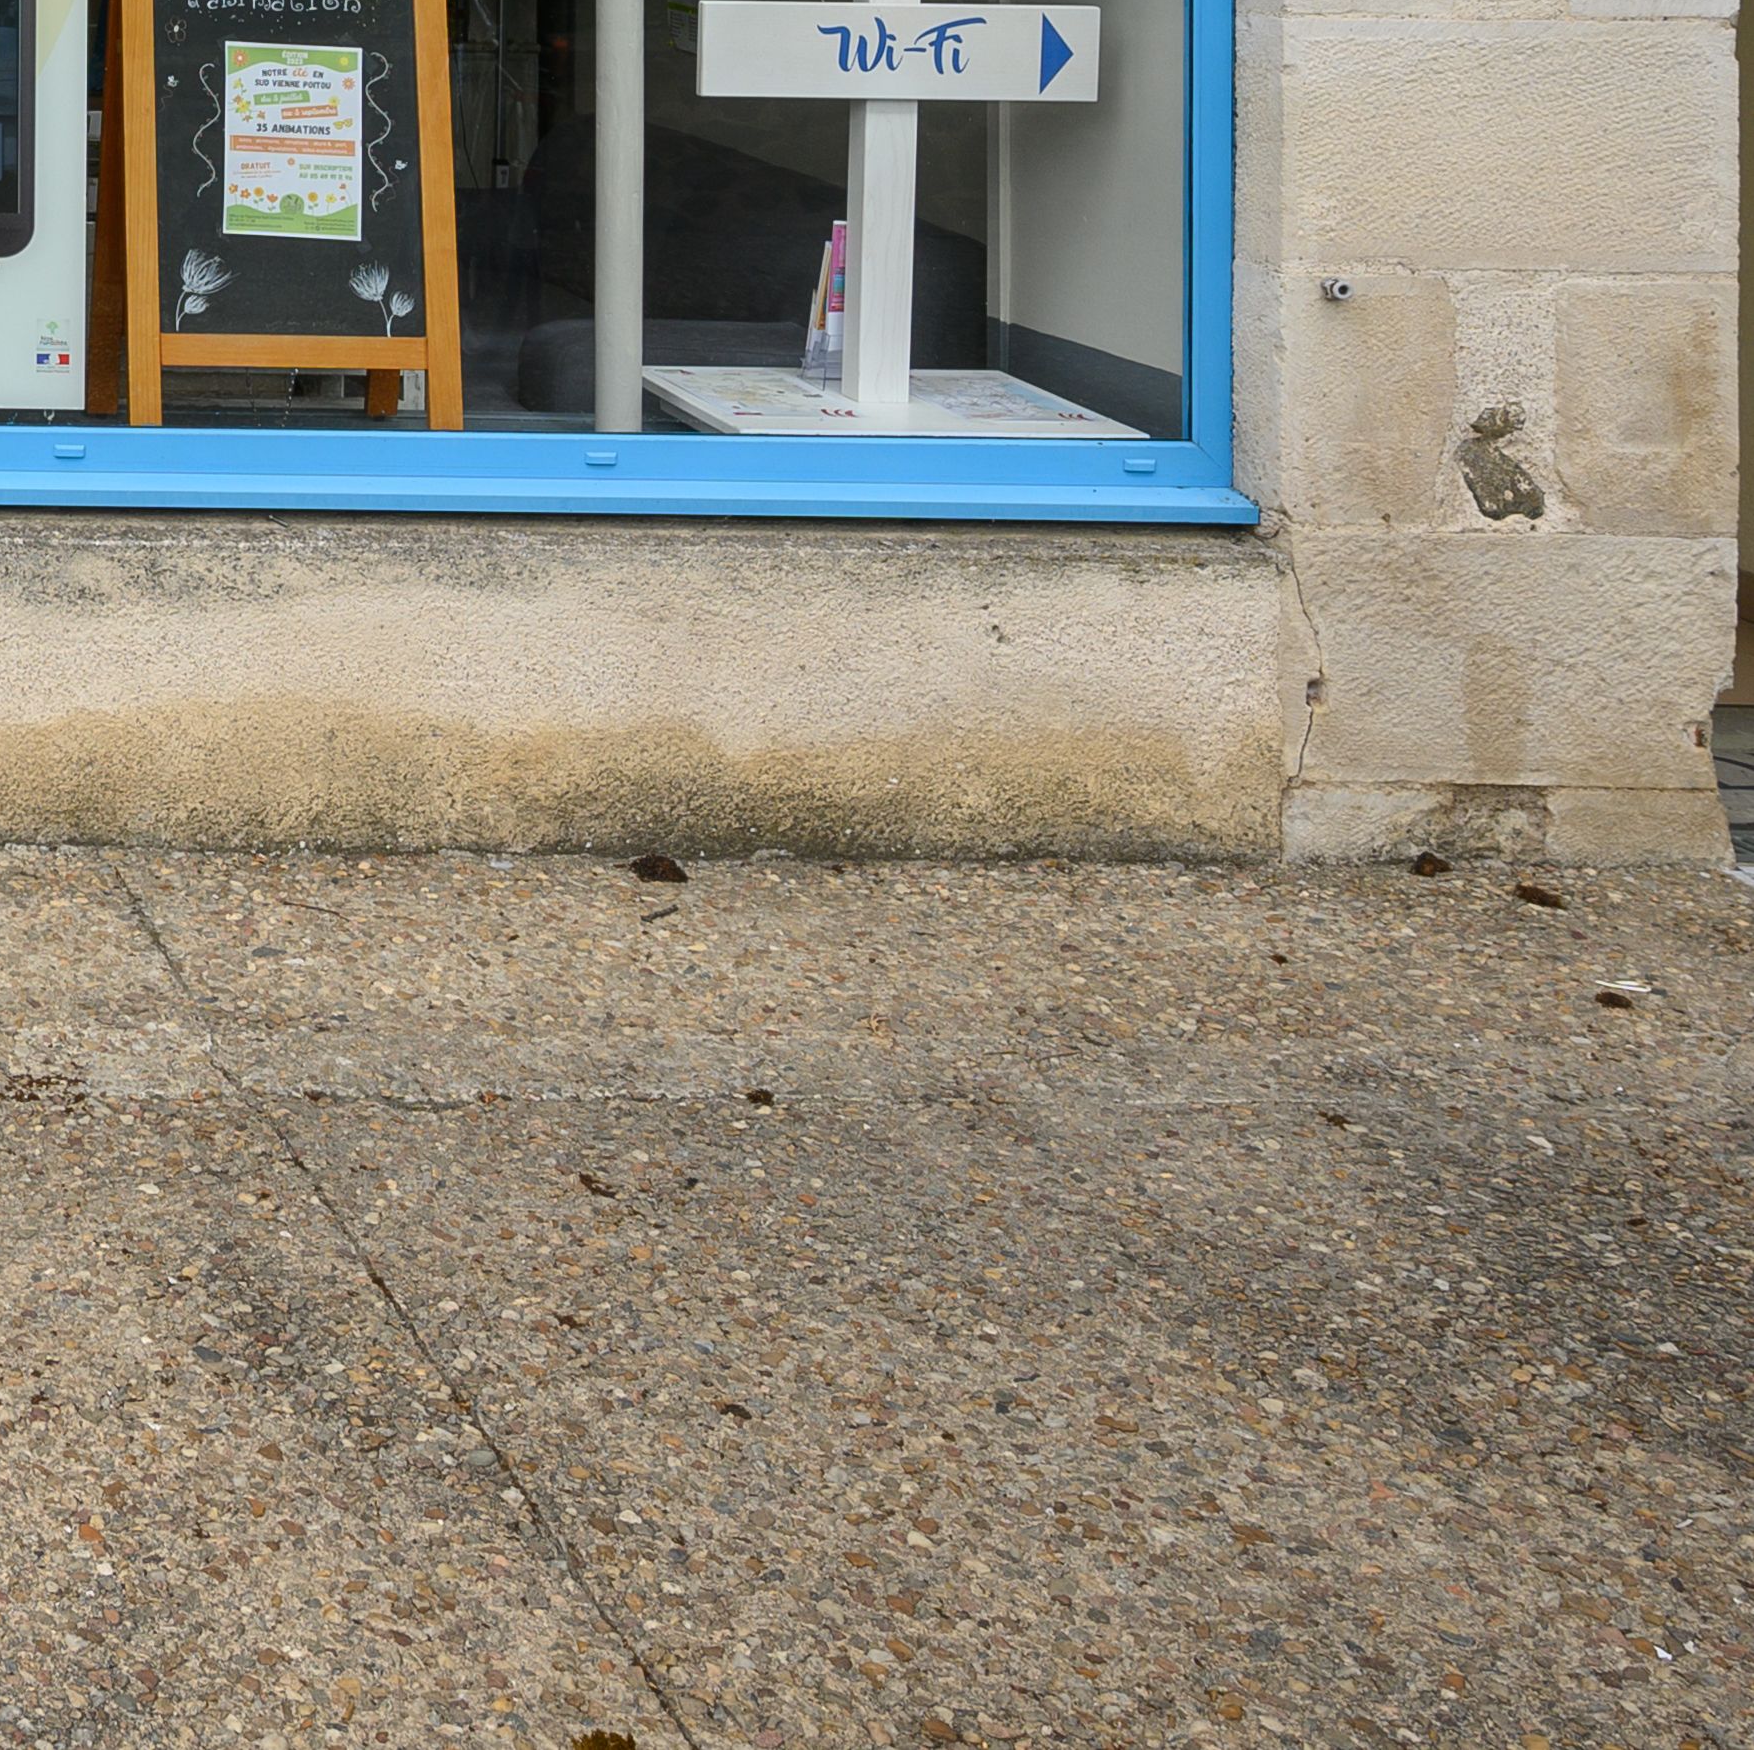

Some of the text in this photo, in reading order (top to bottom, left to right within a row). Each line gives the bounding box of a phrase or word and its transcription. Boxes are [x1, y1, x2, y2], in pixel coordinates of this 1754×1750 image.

[817, 16, 987, 75] Wi-Fi
[261, 68, 288, 78] NOTRE
[313, 70, 324, 79] EN
[254, 78, 332, 90] SUD VIENNE POITOU
[255, 122, 331, 135] 35 ANIMATIONS
[240, 162, 271, 171] GRATUIT
